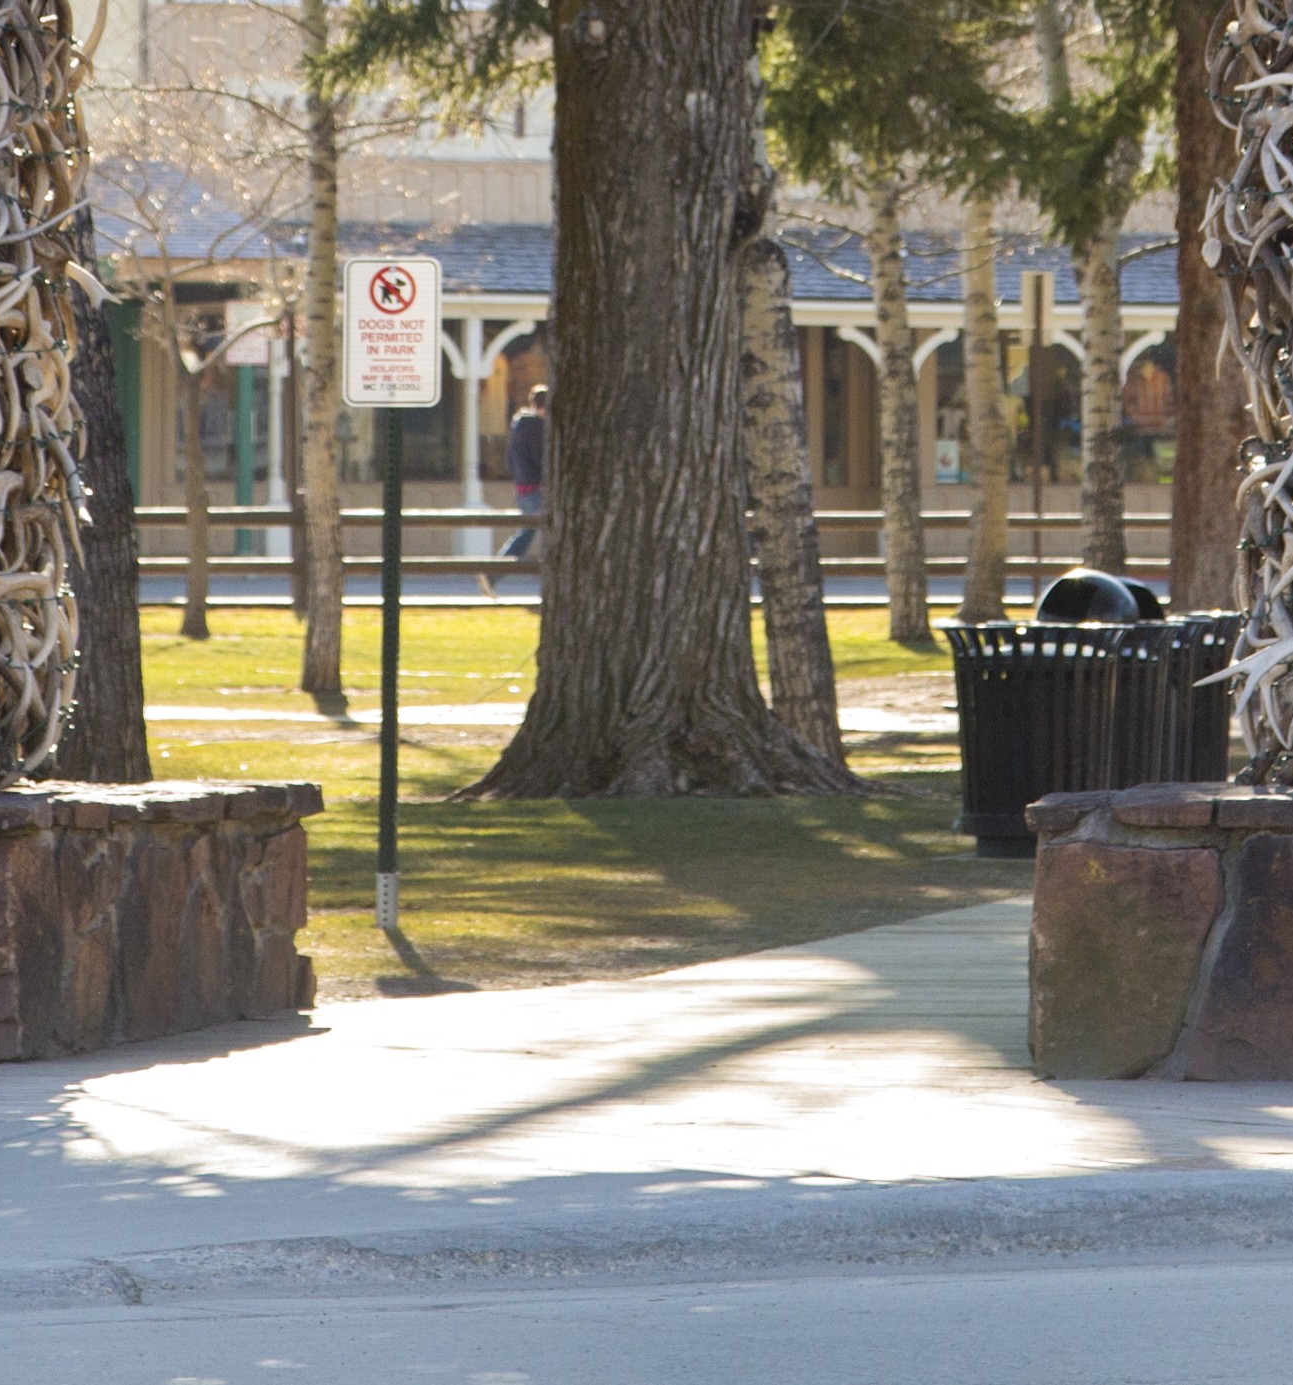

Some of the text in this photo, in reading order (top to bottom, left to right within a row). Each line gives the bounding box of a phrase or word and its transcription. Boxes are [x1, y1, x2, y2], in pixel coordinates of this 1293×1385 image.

[357, 319, 425, 330] DOGS NOT
[366, 345, 416, 355] IN PARK
[368, 365, 414, 373] VIOLATORS
[361, 374, 421, 382] MAY BE CITED
